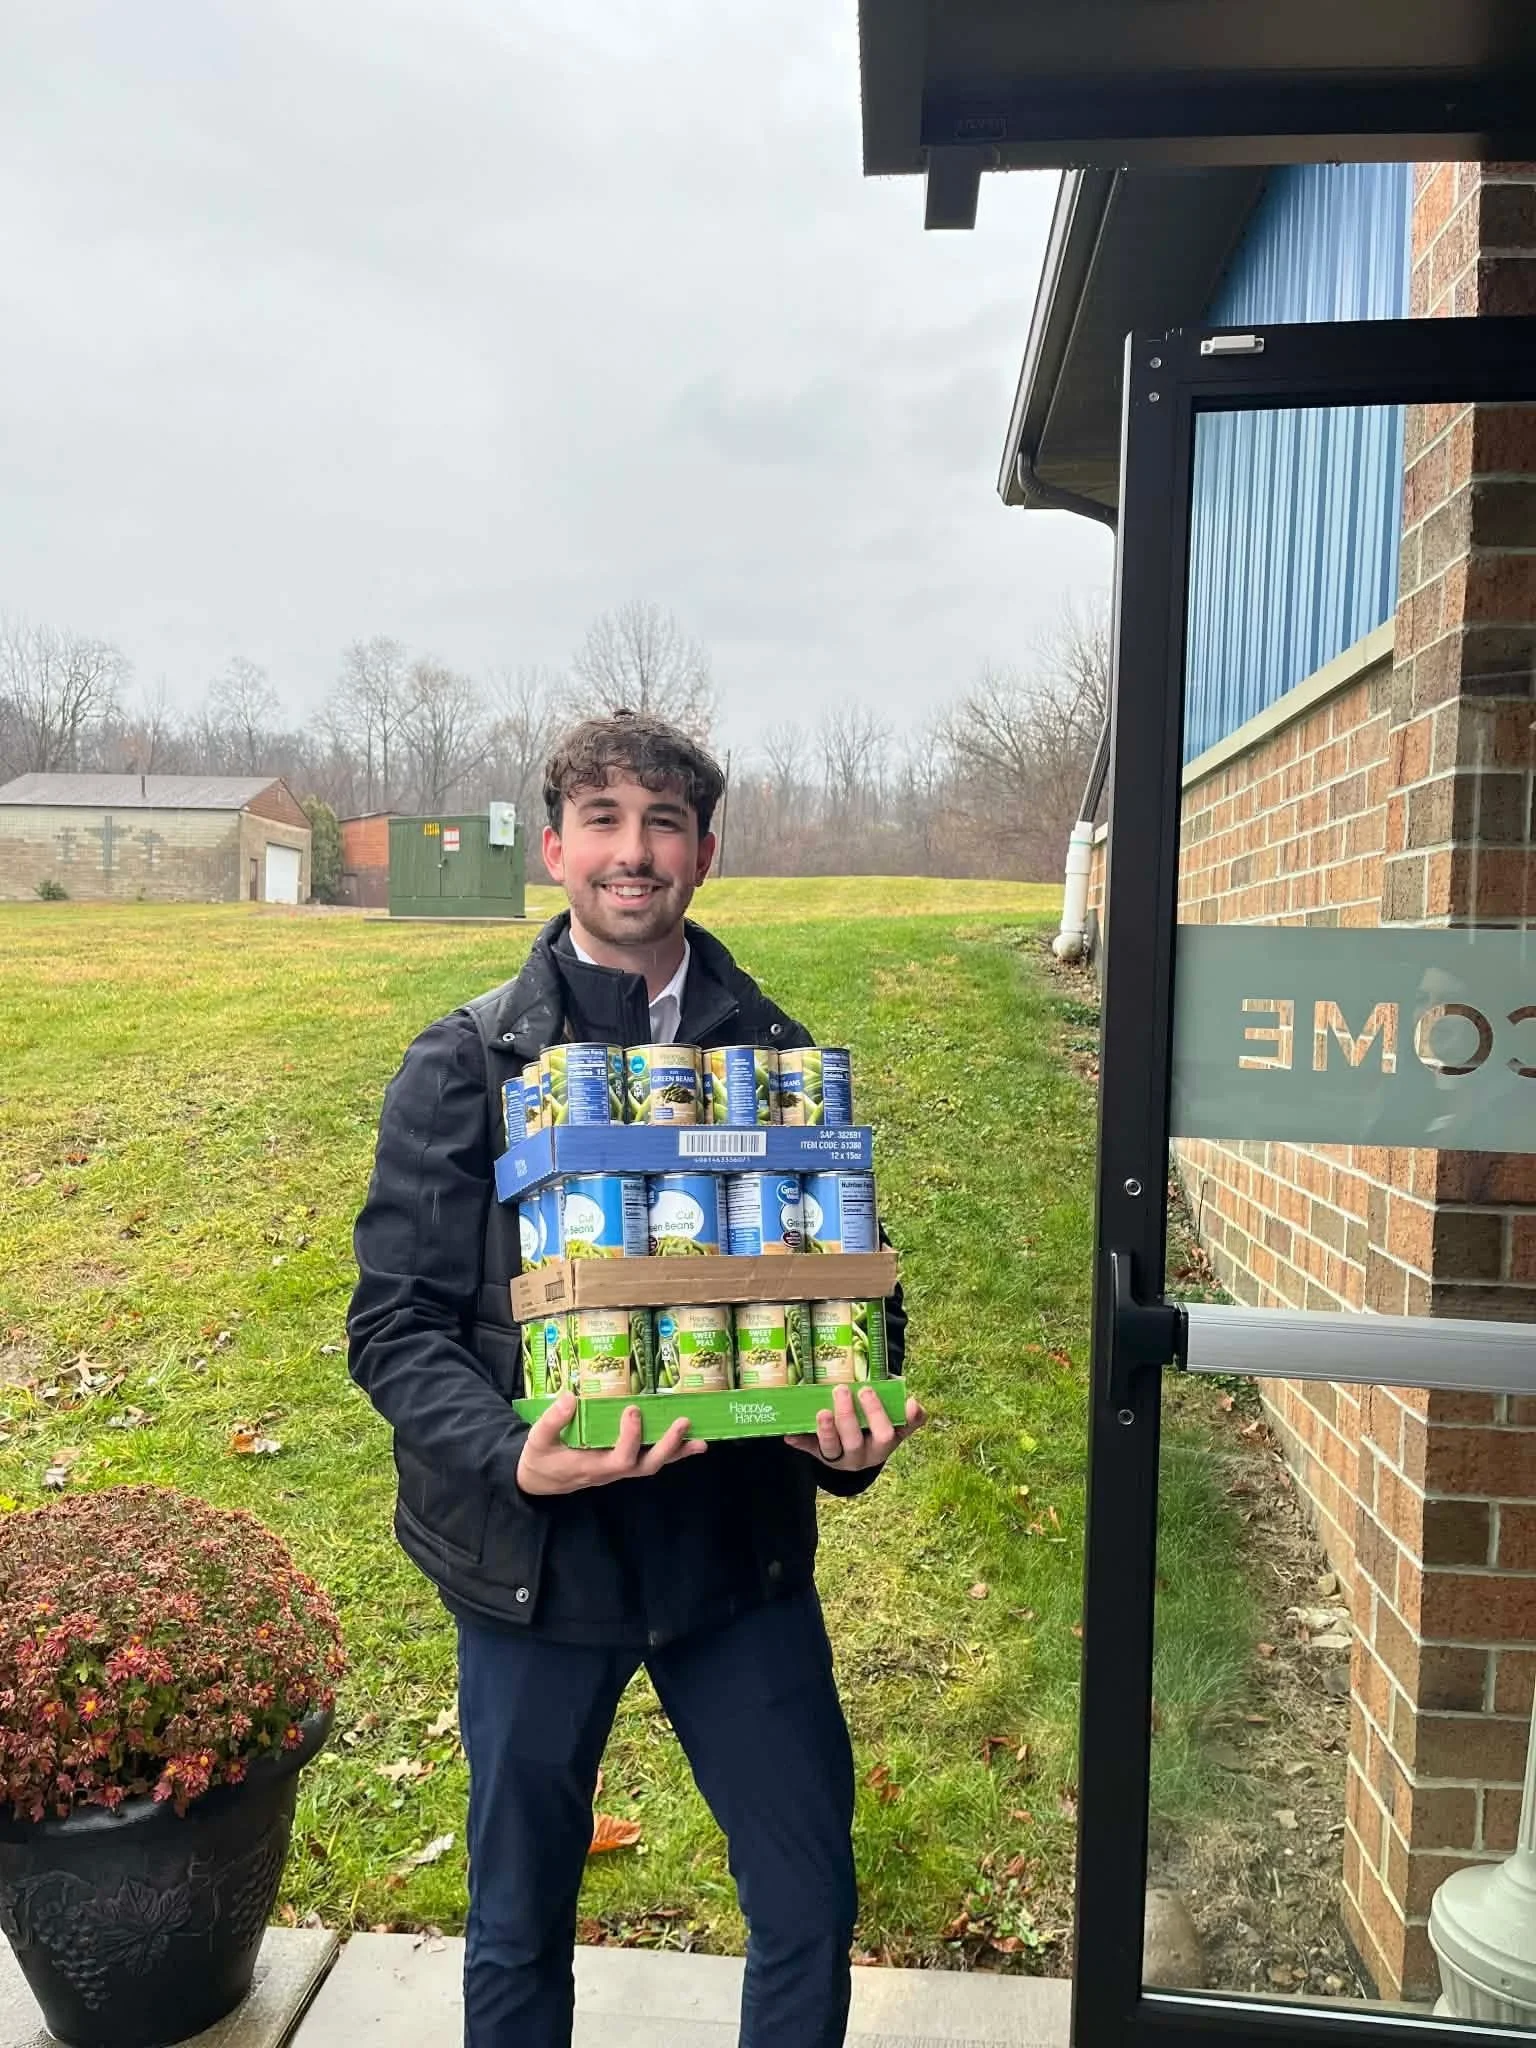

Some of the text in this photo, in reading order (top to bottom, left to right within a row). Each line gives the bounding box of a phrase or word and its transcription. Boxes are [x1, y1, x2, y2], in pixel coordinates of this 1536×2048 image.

[652, 1075, 695, 1083] GREEN BEANS
[801, 1140, 818, 1149] ITEM
[832, 1151, 840, 1160] 12
[847, 1151, 862, 1160] 15oz
[578, 1214, 594, 1223] Cut
[676, 1210, 694, 1220] Cut
[665, 1222, 695, 1231] Beans
[748, 1329, 772, 1337] SWEET
[816, 1326, 840, 1334] SWEET
[591, 1336, 616, 1344] SWEET
[692, 1331, 716, 1340] SWEET
[751, 1336, 771, 1344] PEAS
[819, 1333, 837, 1341] PEAS
[696, 1339, 715, 1347] PEAS
[594, 1344, 614, 1353] PEAS
[729, 1401, 765, 1414] Happy
[735, 1412, 777, 1425] Harvest
